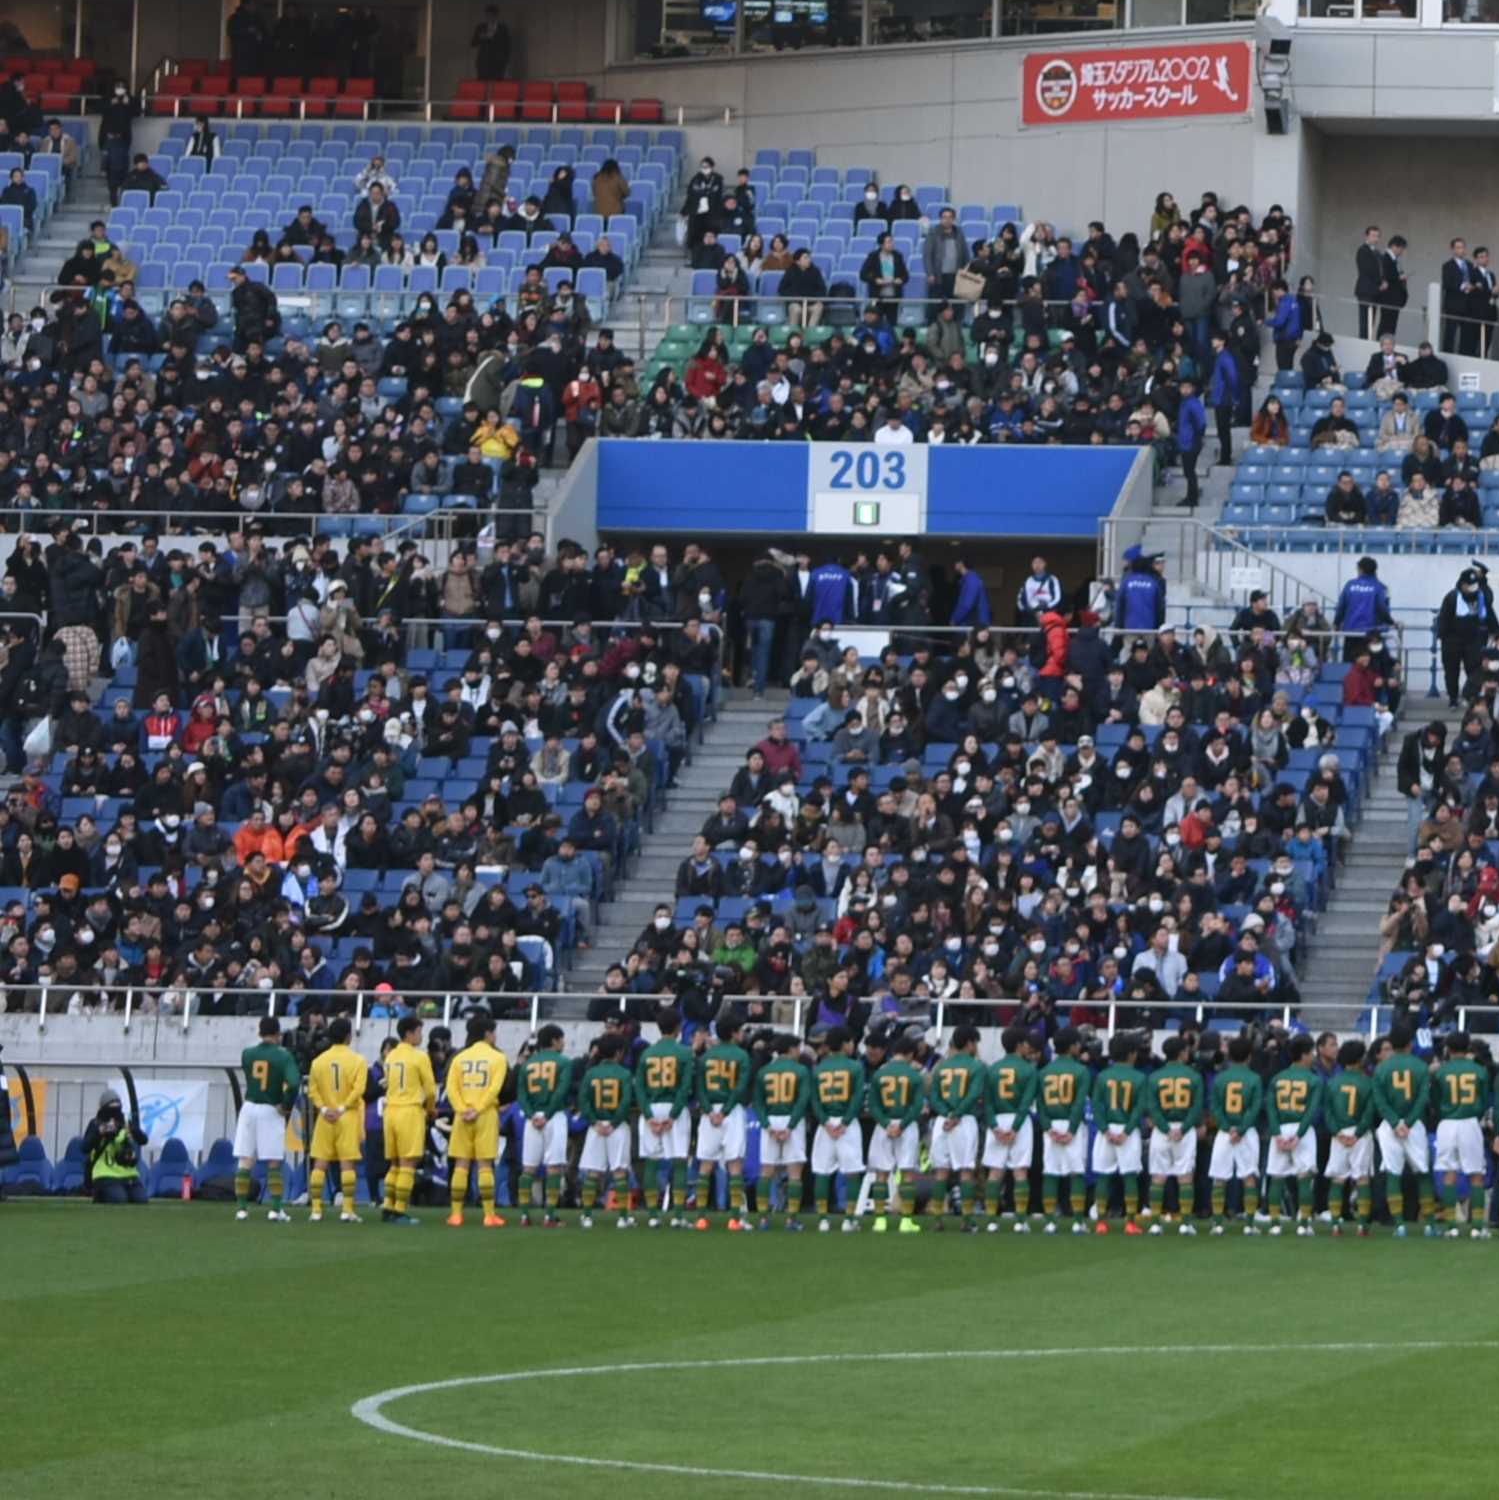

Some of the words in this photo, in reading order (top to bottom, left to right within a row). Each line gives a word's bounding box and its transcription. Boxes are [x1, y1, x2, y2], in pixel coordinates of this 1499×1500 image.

[1092, 84, 1198, 111] サッカースクール
[829, 449, 907, 491] 203
[251, 1060, 270, 1093] 9
[331, 1063, 340, 1093] 1
[460, 1060, 490, 1089] 25
[526, 1060, 557, 1093] 29
[645, 1056, 677, 1088] 28
[705, 1059, 738, 1091] 24
[819, 1070, 851, 1103] 23
[939, 1068, 969, 1100] 27
[998, 1067, 1016, 1100] 2
[1392, 1070, 1413, 1101] 4
[591, 1078, 621, 1110] 13
[764, 1072, 797, 1105] 30
[880, 1076, 909, 1108] 21
[1043, 1073, 1076, 1106] 20
[1107, 1080, 1133, 1112] 11
[1158, 1077, 1192, 1110] 26
[1225, 1082, 1243, 1114] 6
[1276, 1080, 1308, 1112] 22
[1340, 1085, 1357, 1117] 7
[1446, 1073, 1477, 1105] 15
